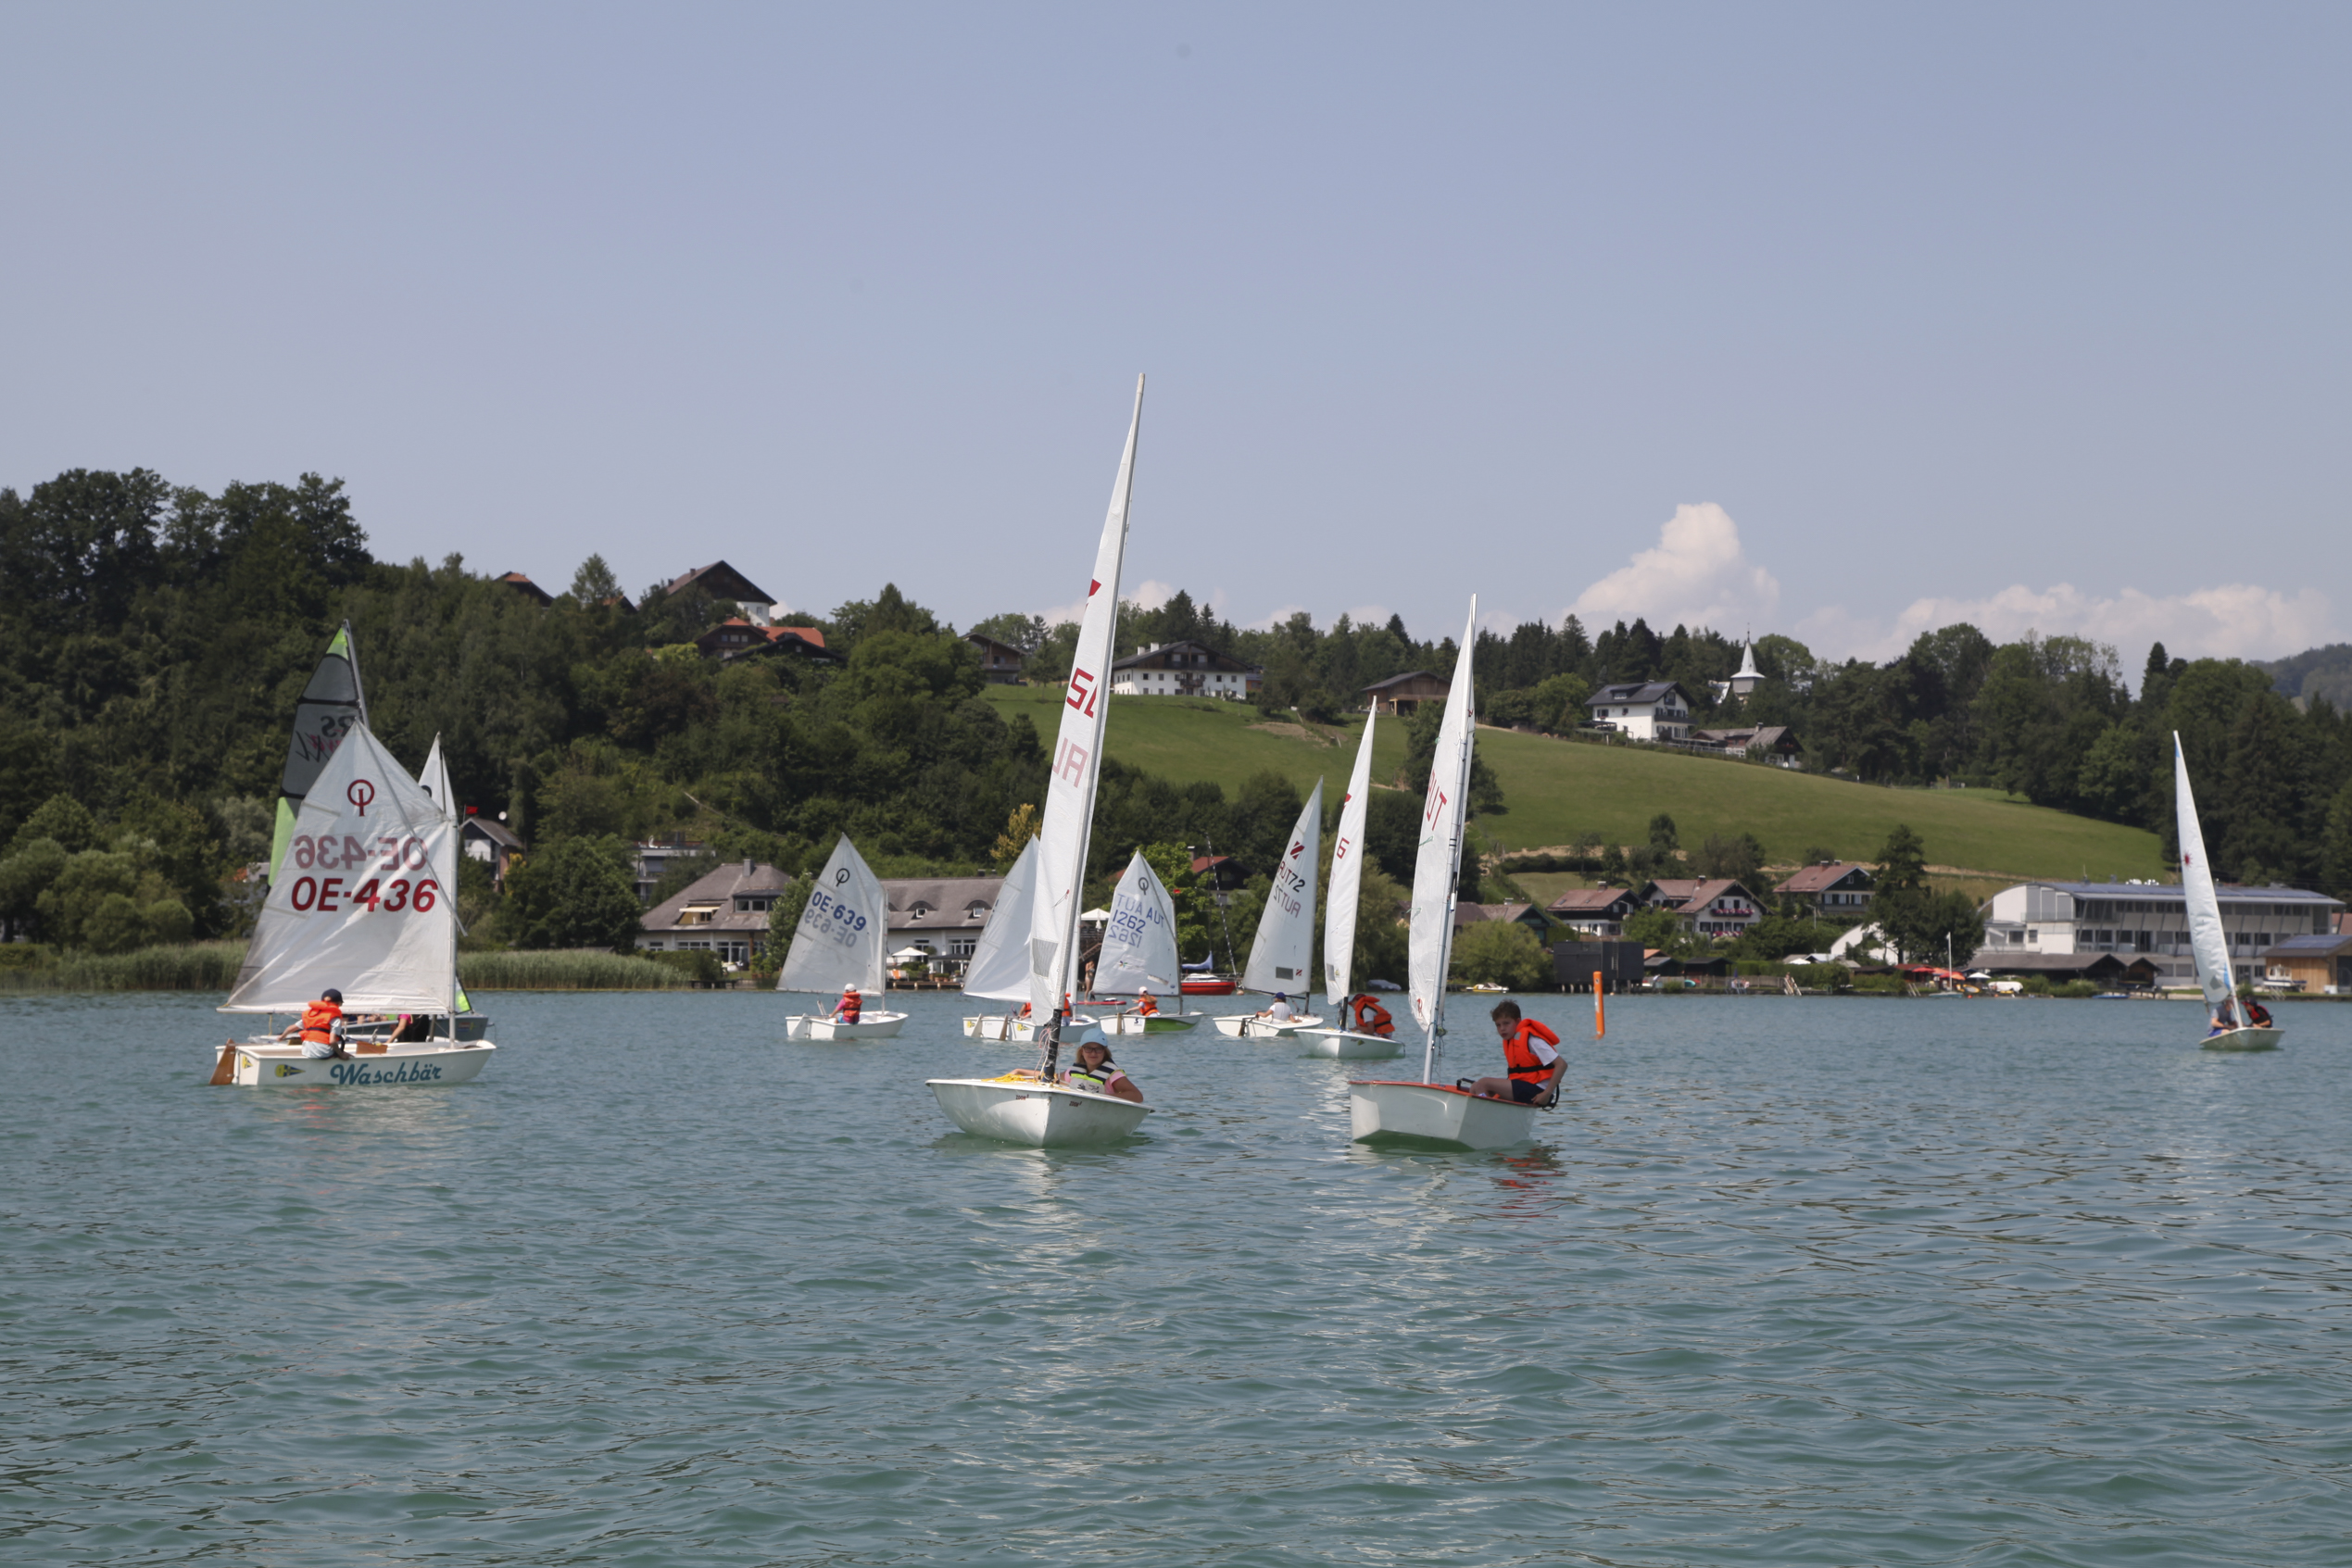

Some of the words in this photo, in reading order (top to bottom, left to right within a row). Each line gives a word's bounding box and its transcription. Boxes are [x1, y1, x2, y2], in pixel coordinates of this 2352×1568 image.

[291, 876, 438, 912] OE-436
[1113, 909, 1146, 934] 1262
[1146, 907, 1164, 928] AUT
[330, 1061, 442, 1085] Waschbär
